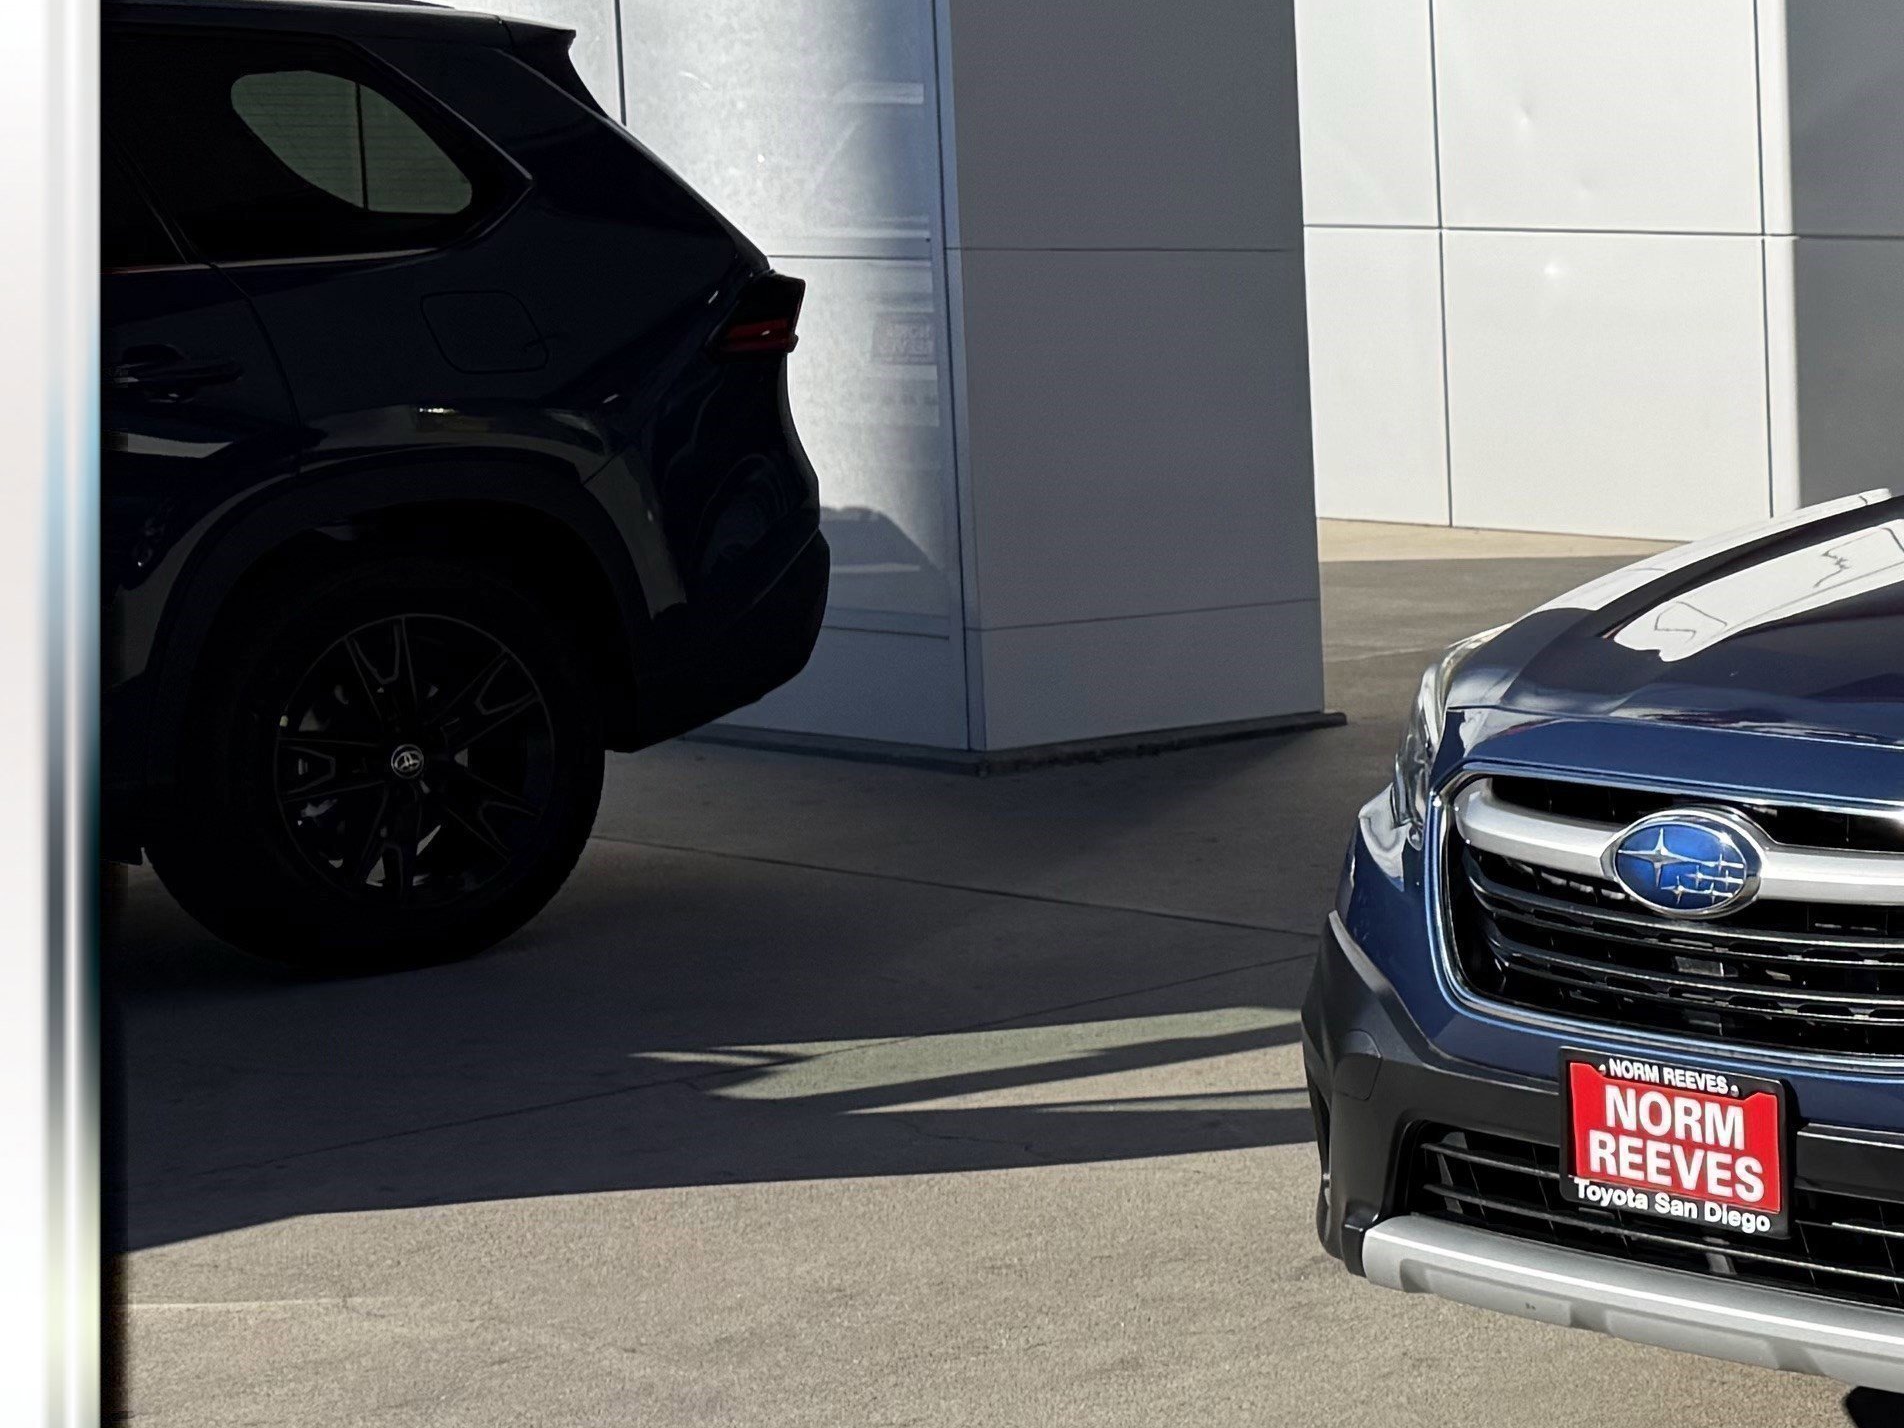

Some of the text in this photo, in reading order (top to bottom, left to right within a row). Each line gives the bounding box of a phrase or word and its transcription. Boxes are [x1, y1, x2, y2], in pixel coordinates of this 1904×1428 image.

[1608, 1058, 1729, 1095] NORM REEVES
[1605, 1084, 1746, 1151] NORM
[1588, 1128, 1766, 1203] REEVES
[1574, 1177, 1771, 1235] Toyota San Diego
